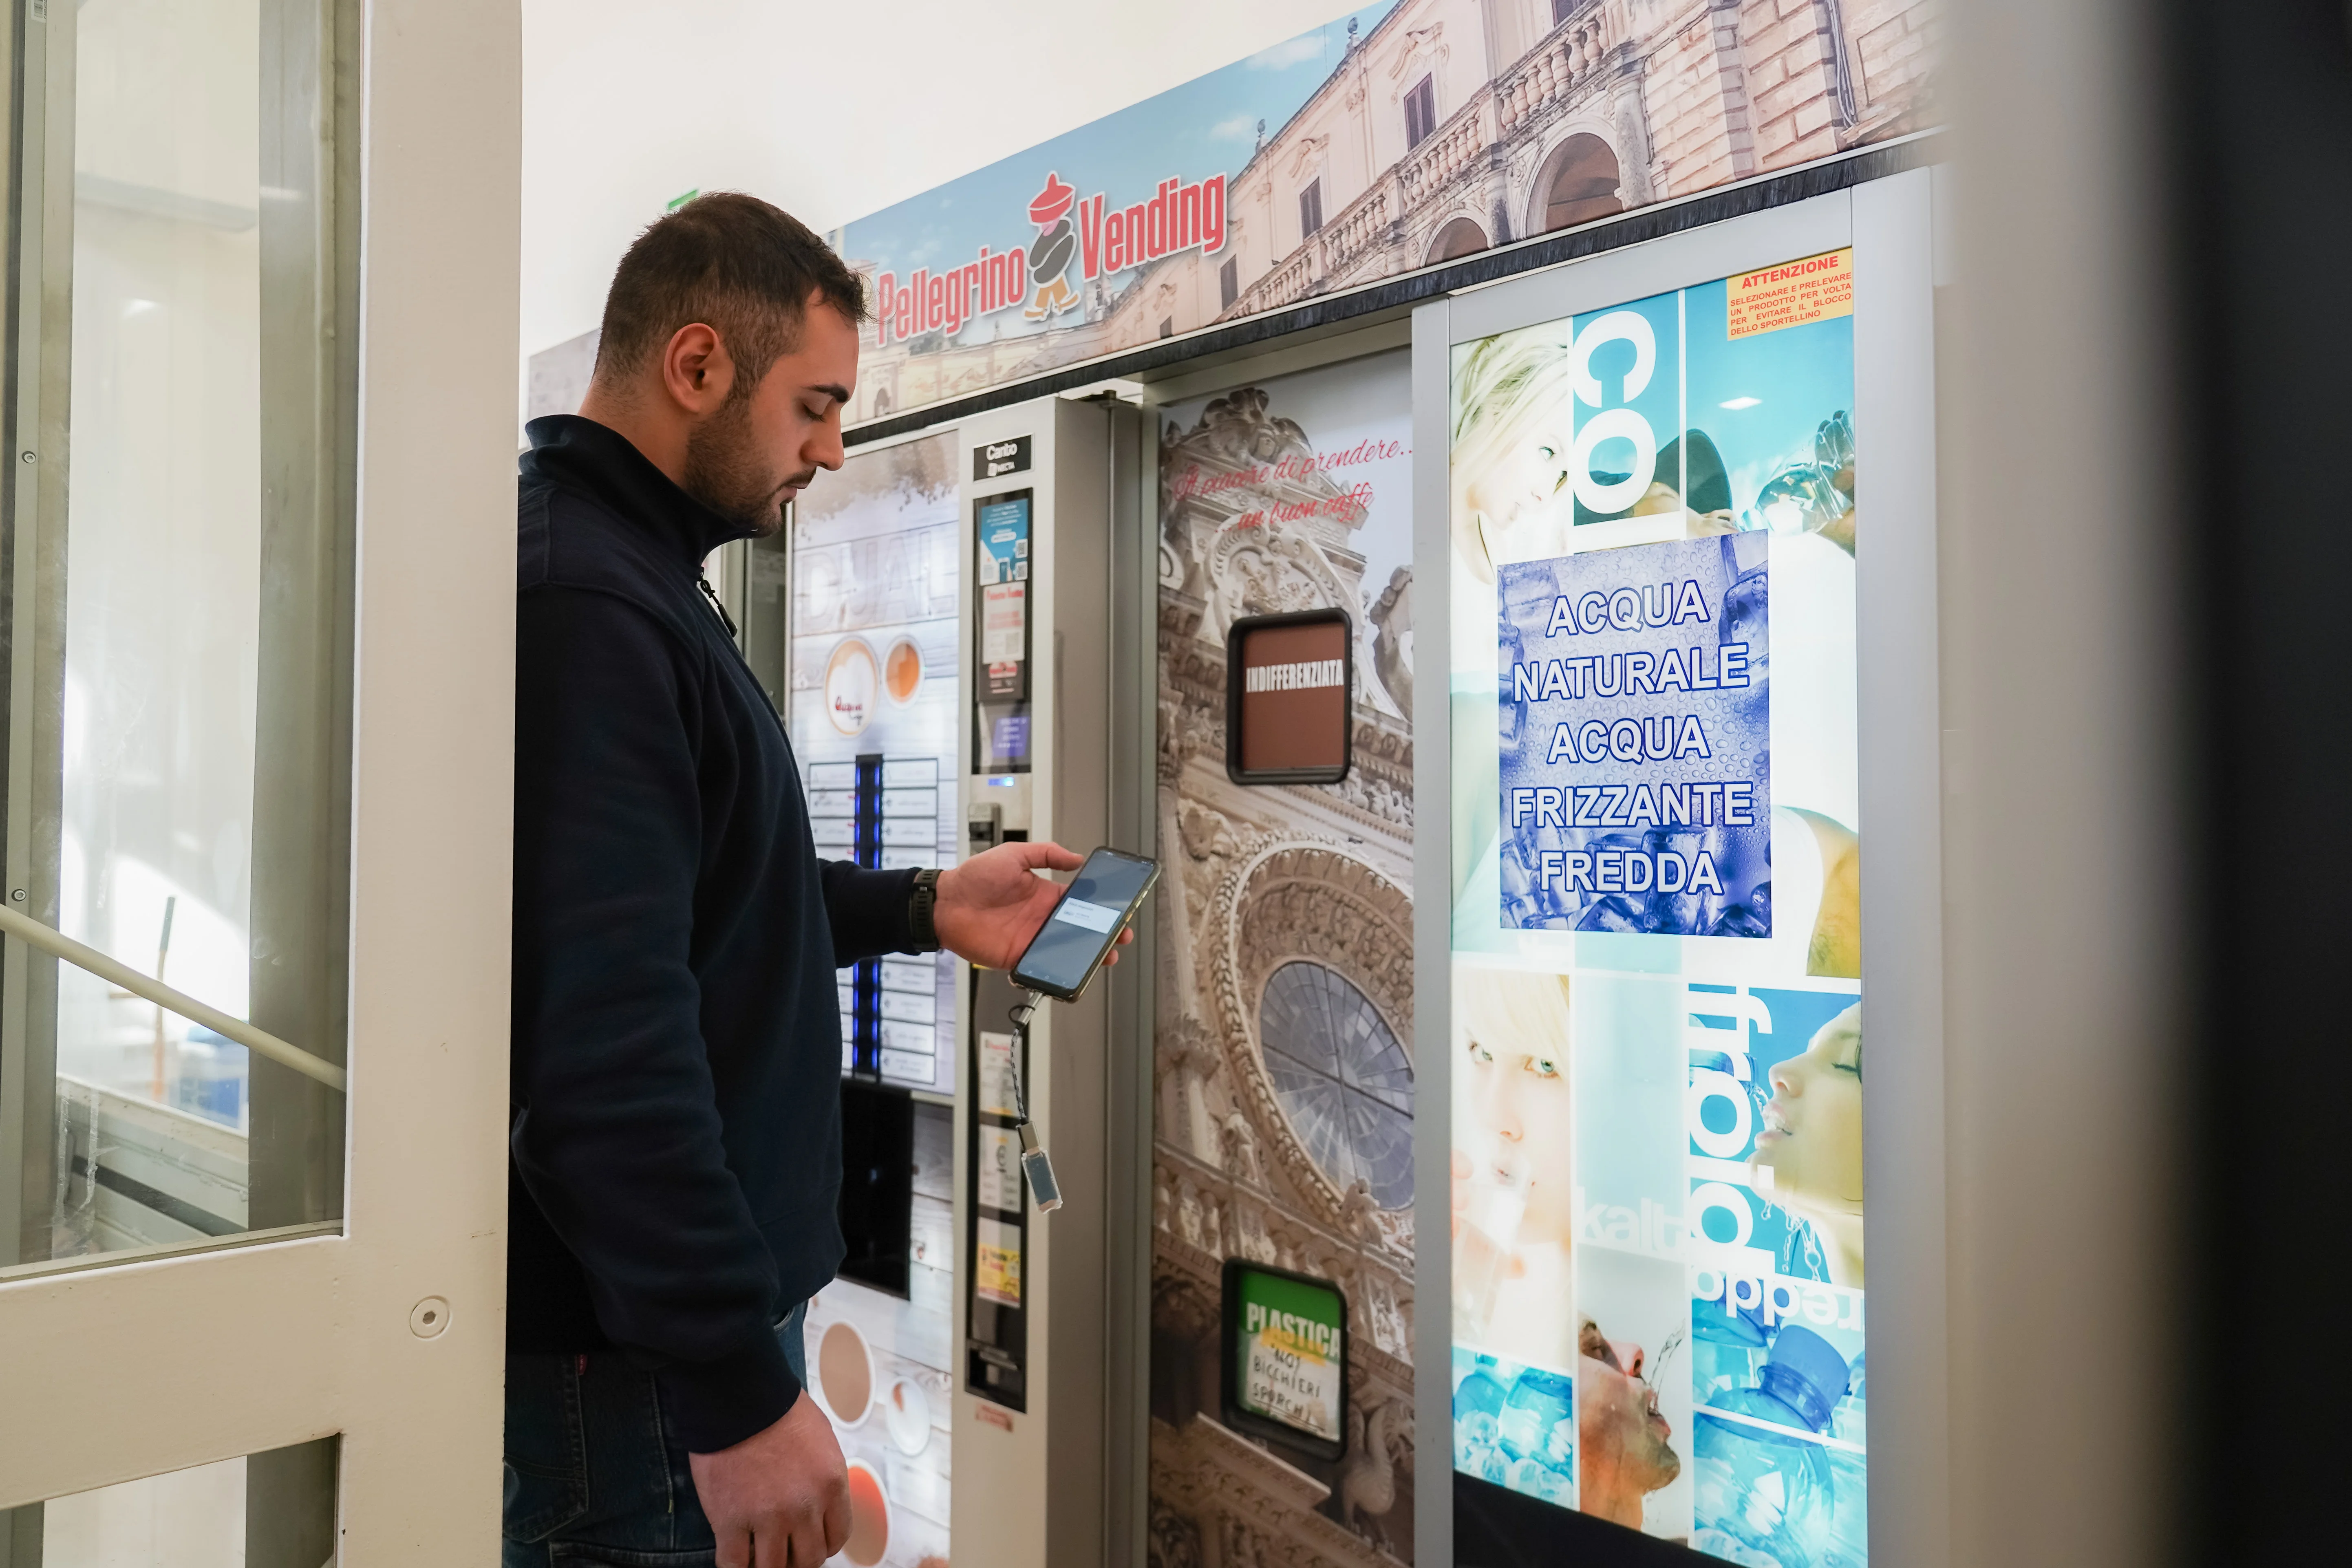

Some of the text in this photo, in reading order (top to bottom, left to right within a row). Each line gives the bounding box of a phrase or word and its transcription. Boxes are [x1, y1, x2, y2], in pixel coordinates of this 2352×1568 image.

[876, 173, 1227, 346] Pellegrino Vending
[1742, 256, 1838, 289] ATTENZIONE
[1730, 287, 1788, 306] SELEZIONARE
[1800, 272, 1851, 290] PRELEVARE
[1749, 296, 1796, 312] PRODOTTO
[1801, 291, 1818, 300] PER
[1823, 283, 1851, 294] VOLTA
[1731, 317, 1747, 326] PER
[1756, 307, 1792, 320] EVITARE
[1814, 293, 1851, 307] BLOCCO
[1731, 310, 1820, 335] DELLO SPORTELLINO
[986, 443, 1017, 461] Canto
[1274, 454, 1298, 479] di
[1269, 499, 1317, 524] buon
[1546, 580, 1710, 637] ACQUA
[1246, 659, 1344, 693] INDIFFERENZIATA
[1513, 642, 1750, 702] NATURALE
[1547, 715, 1711, 764] ACQUA
[1511, 781, 1754, 828] FRIZZANTE
[1540, 851, 1724, 895] FREDDA
[1246, 1302, 1341, 1358] PLASTICA
[1254, 1356, 1320, 1397] BICCHIERI
